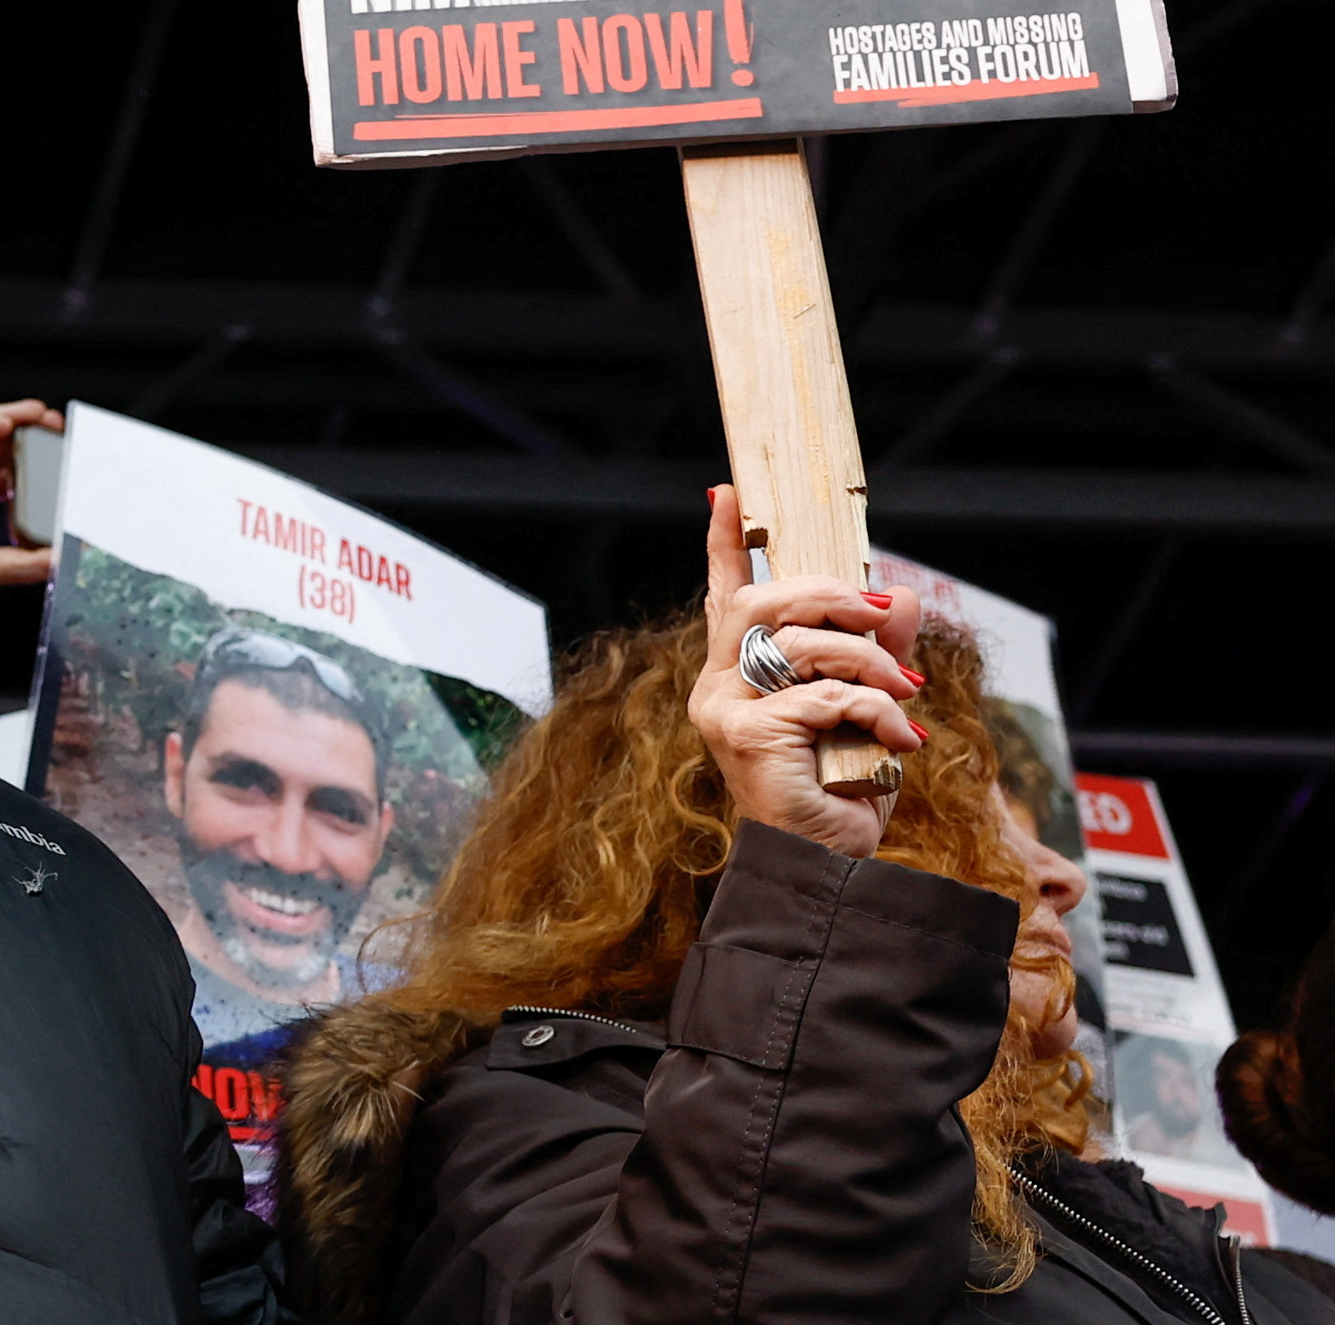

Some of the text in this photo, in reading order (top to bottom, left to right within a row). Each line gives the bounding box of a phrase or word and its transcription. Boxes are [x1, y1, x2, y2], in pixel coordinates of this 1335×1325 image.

[353, 19, 542, 107] HOME
[828, 11, 1084, 55] HOSTAGES AND MISSING
[831, 39, 1091, 93] FAMILIES FORUM
[236, 497, 414, 602] TAMIR ADAR
[298, 564, 356, 625] (38)
